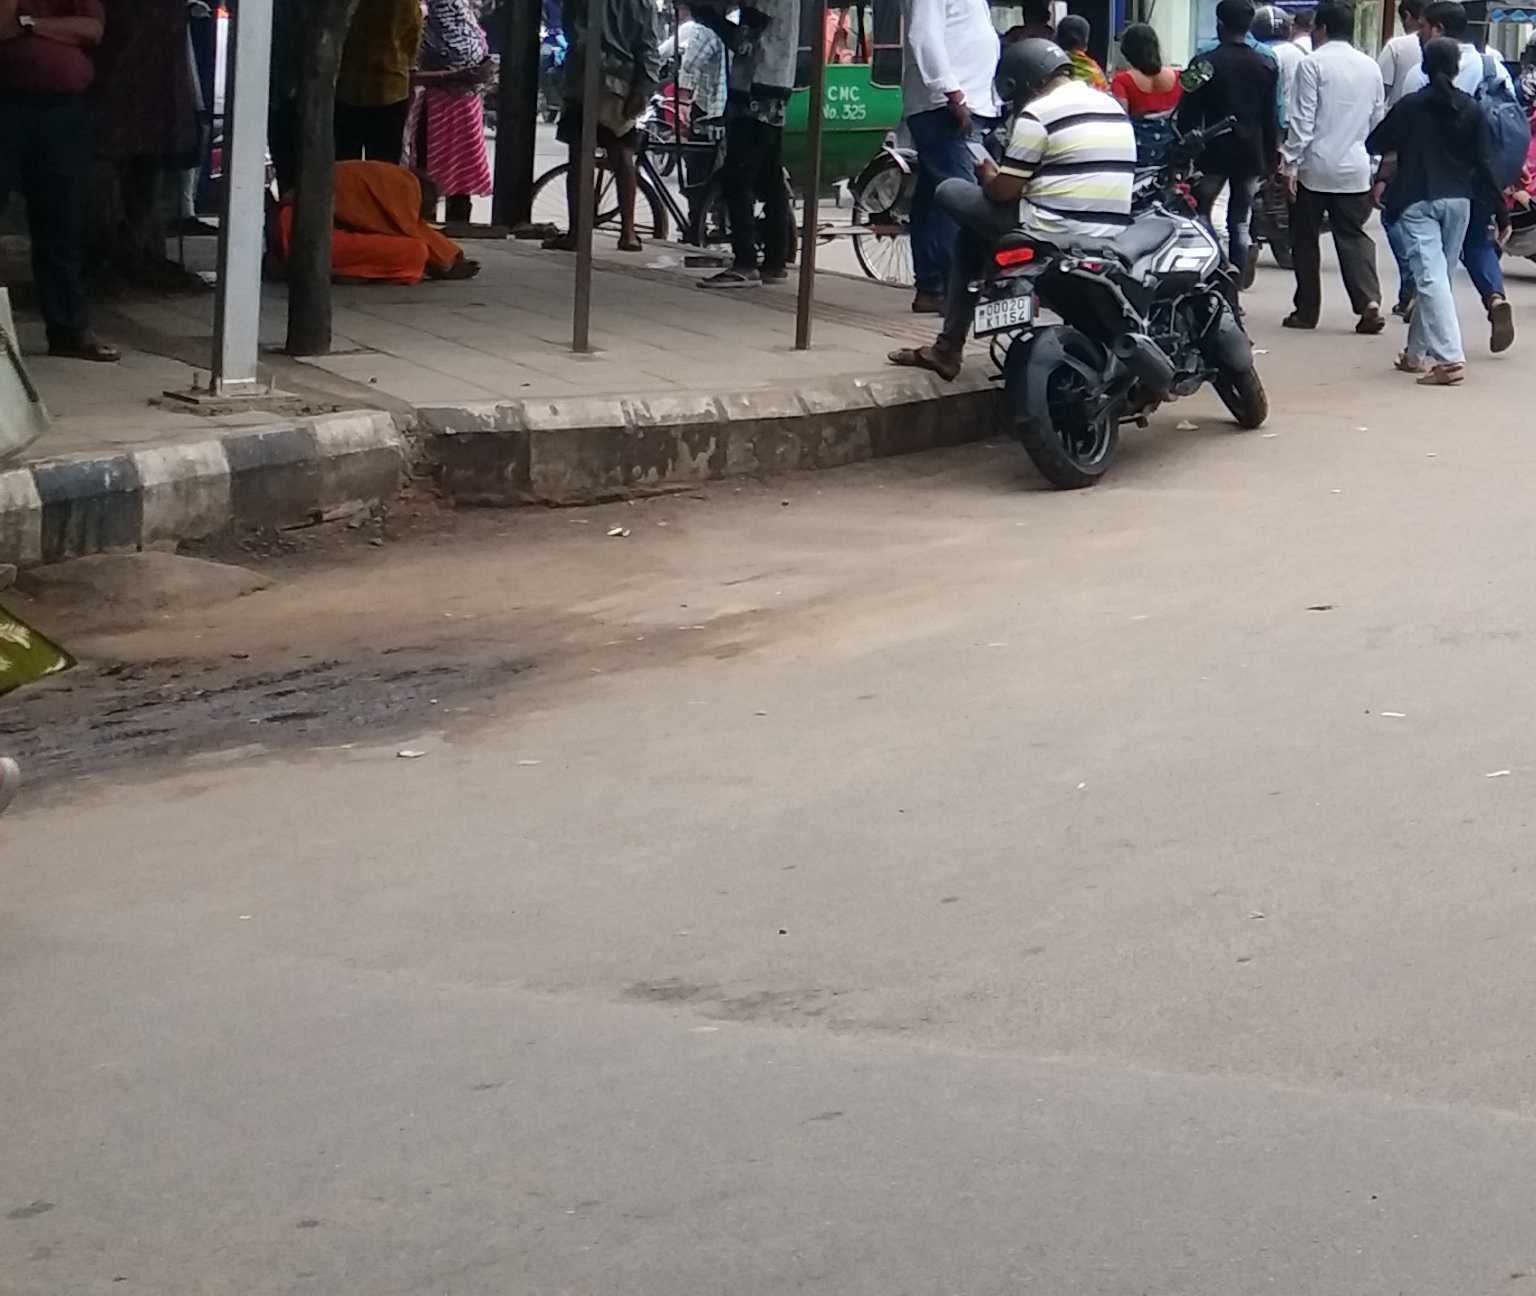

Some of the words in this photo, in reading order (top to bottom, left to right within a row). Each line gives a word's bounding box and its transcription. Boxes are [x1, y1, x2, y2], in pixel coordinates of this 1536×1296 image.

[827, 85, 860, 101] CMC
[842, 104, 866, 120] 325
[986, 310, 1025, 328] K1154
